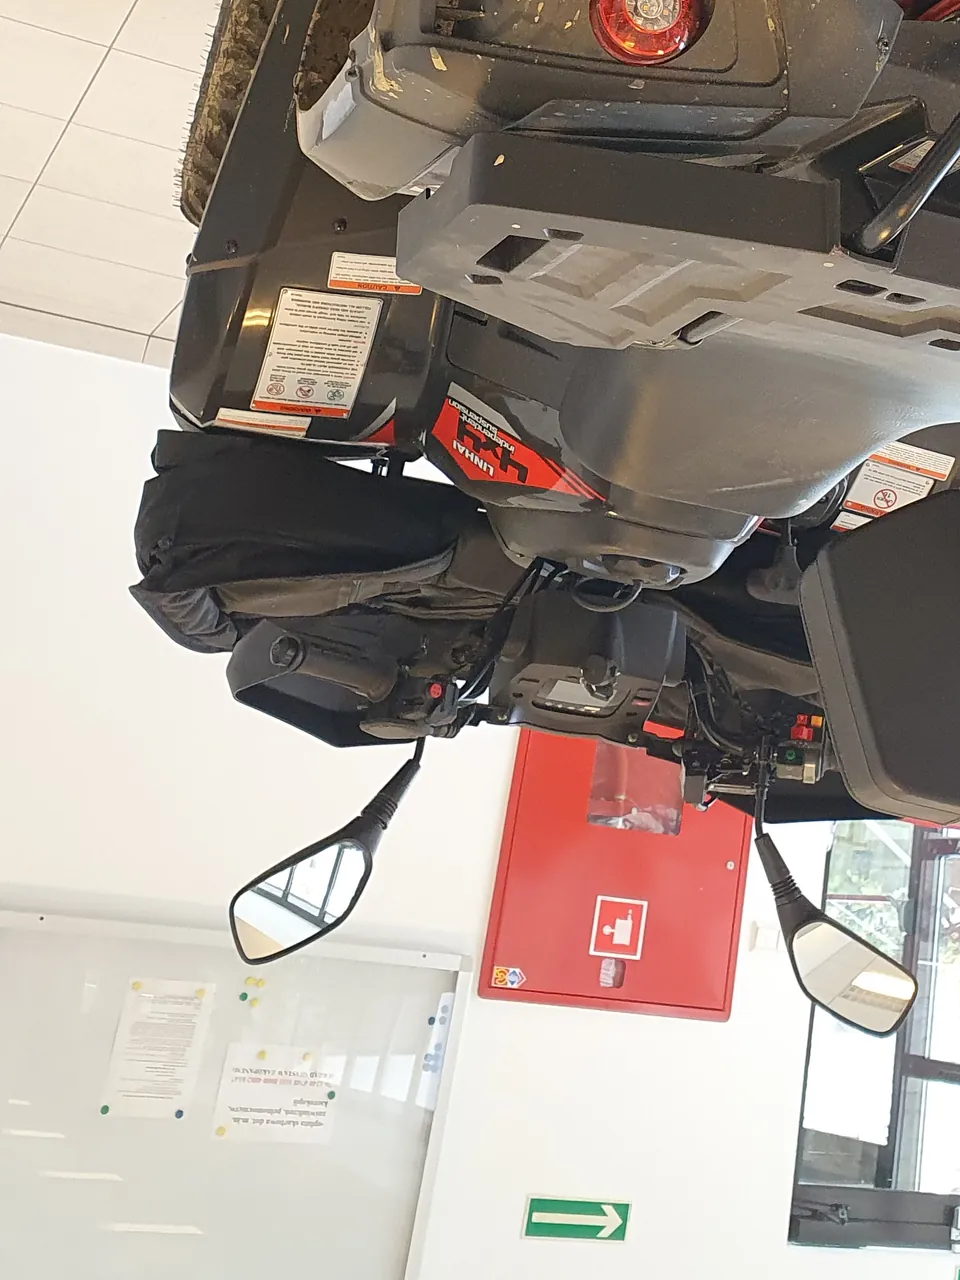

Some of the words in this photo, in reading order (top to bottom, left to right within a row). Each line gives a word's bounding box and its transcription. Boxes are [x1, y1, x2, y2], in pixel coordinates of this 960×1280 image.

[358, 283, 388, 292] CAUTION
[448, 399, 498, 438] suspension
[460, 414, 515, 455] independent
[452, 440, 494, 477] LINHAI
